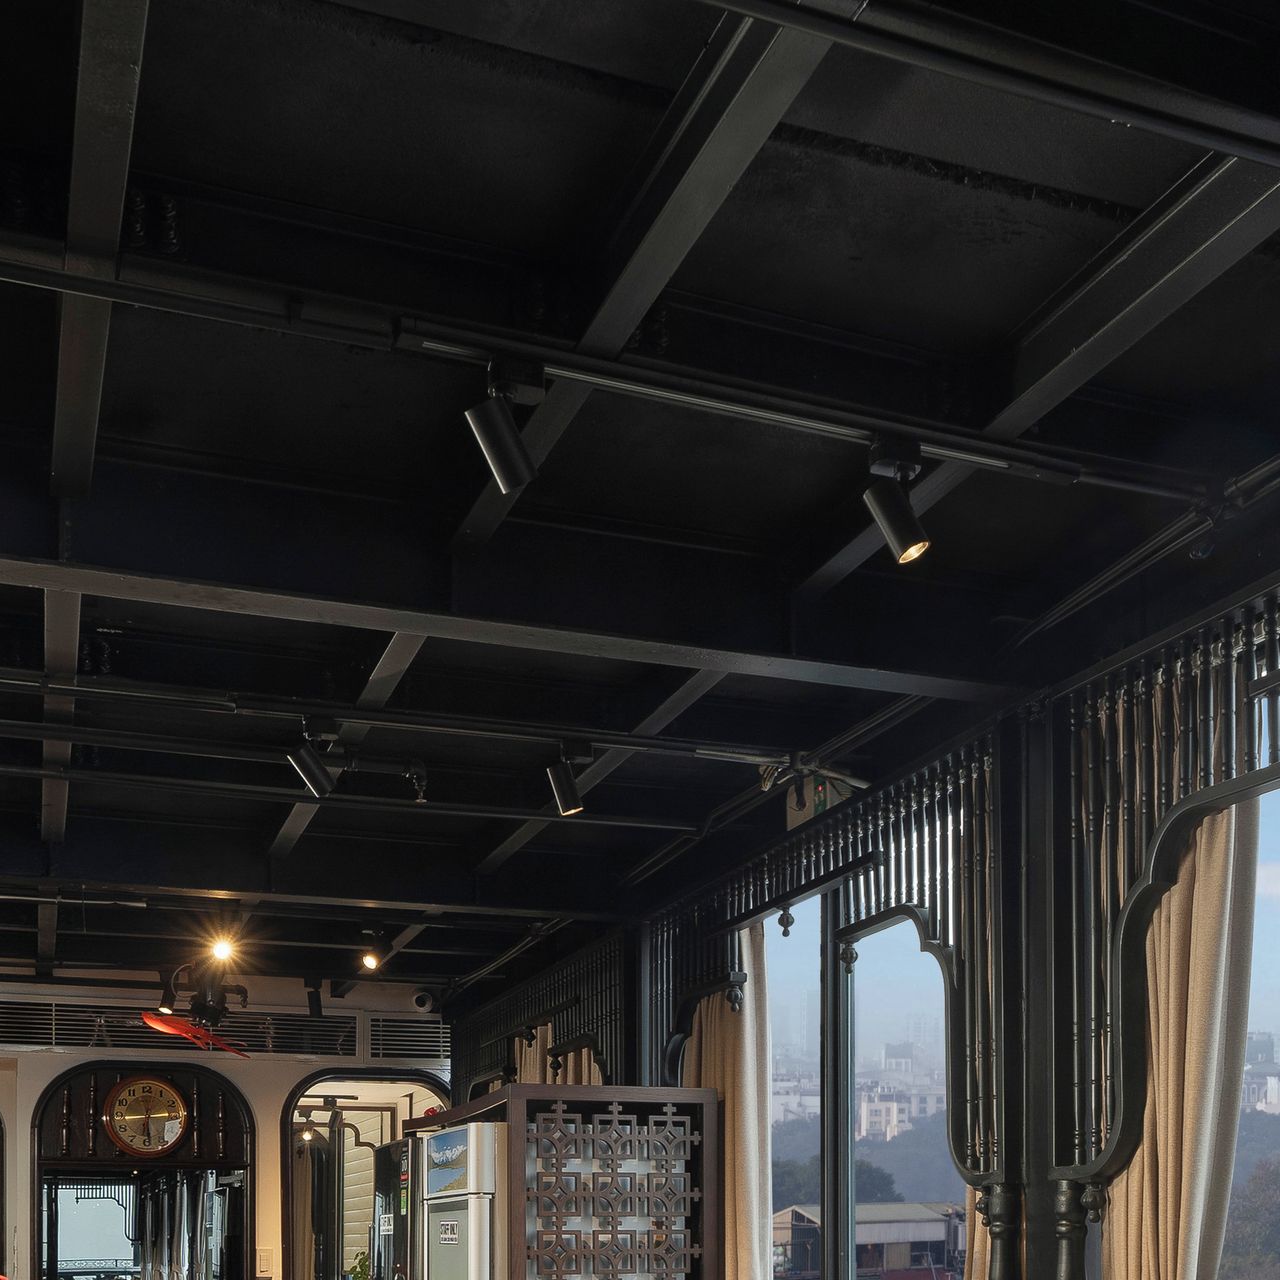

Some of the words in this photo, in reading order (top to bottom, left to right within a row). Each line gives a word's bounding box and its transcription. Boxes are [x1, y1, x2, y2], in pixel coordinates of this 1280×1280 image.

[128, 1088, 136, 1097] 11
[142, 1085, 152, 1094] 12
[118, 1098, 128, 1106] 10
[167, 1099, 176, 1108] 2
[114, 1112, 124, 1120] 9
[118, 1124, 127, 1132] 8
[128, 1135, 137, 1143] 7
[143, 1138, 151, 1147] 6
